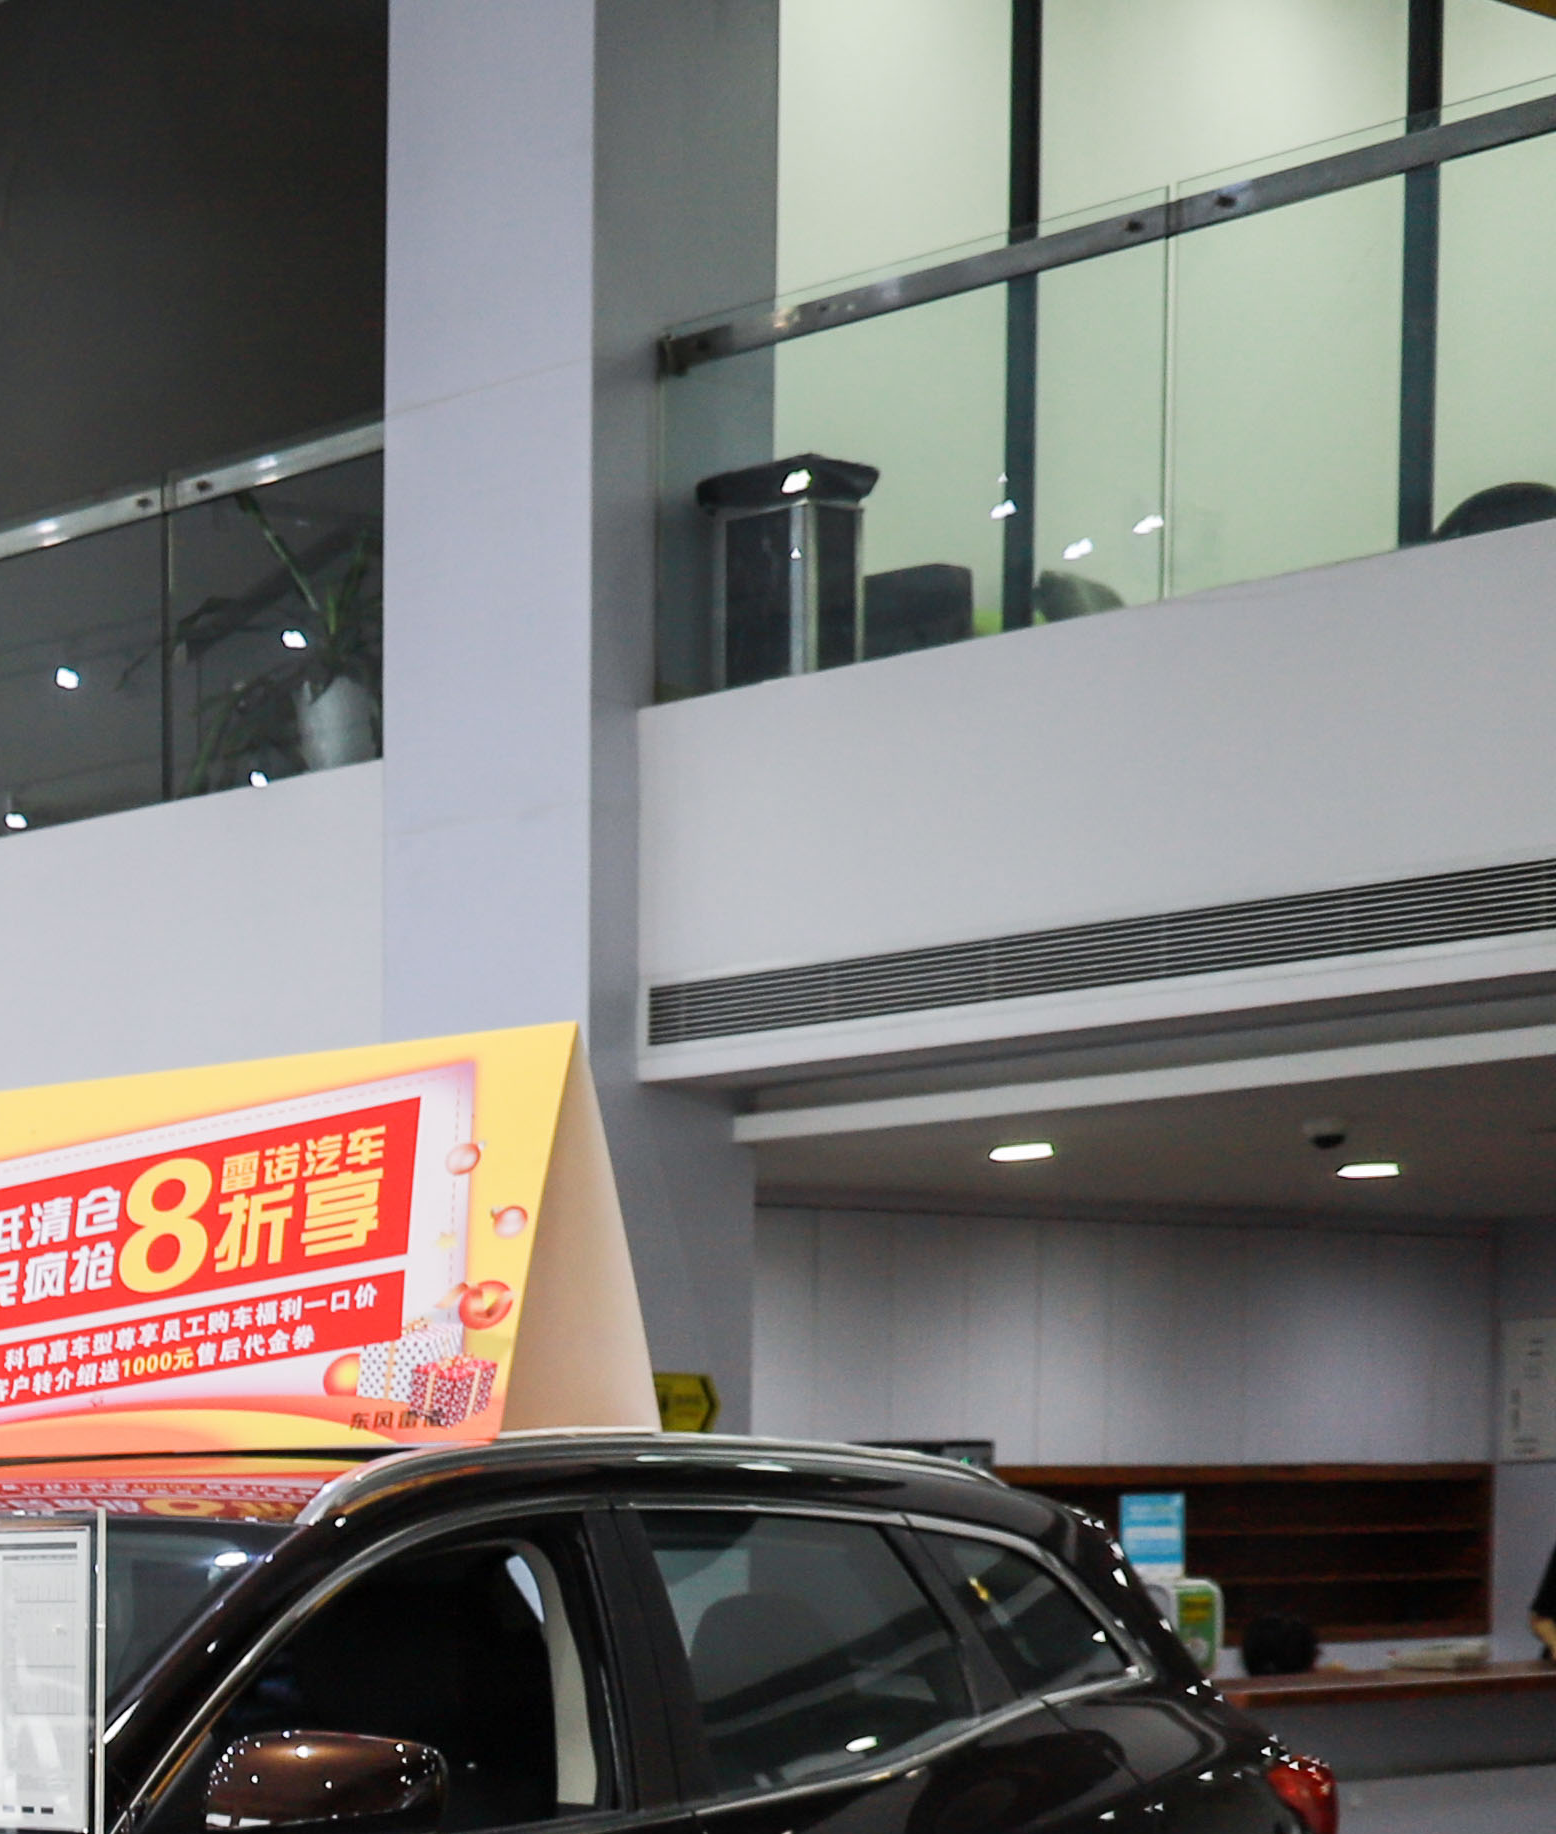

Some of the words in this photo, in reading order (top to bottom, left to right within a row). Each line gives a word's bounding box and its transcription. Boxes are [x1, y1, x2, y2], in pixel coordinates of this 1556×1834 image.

[220, 1126, 387, 1194] 雷诺汽车
[118, 1157, 214, 1294] 8
[215, 1169, 385, 1273] 折享
